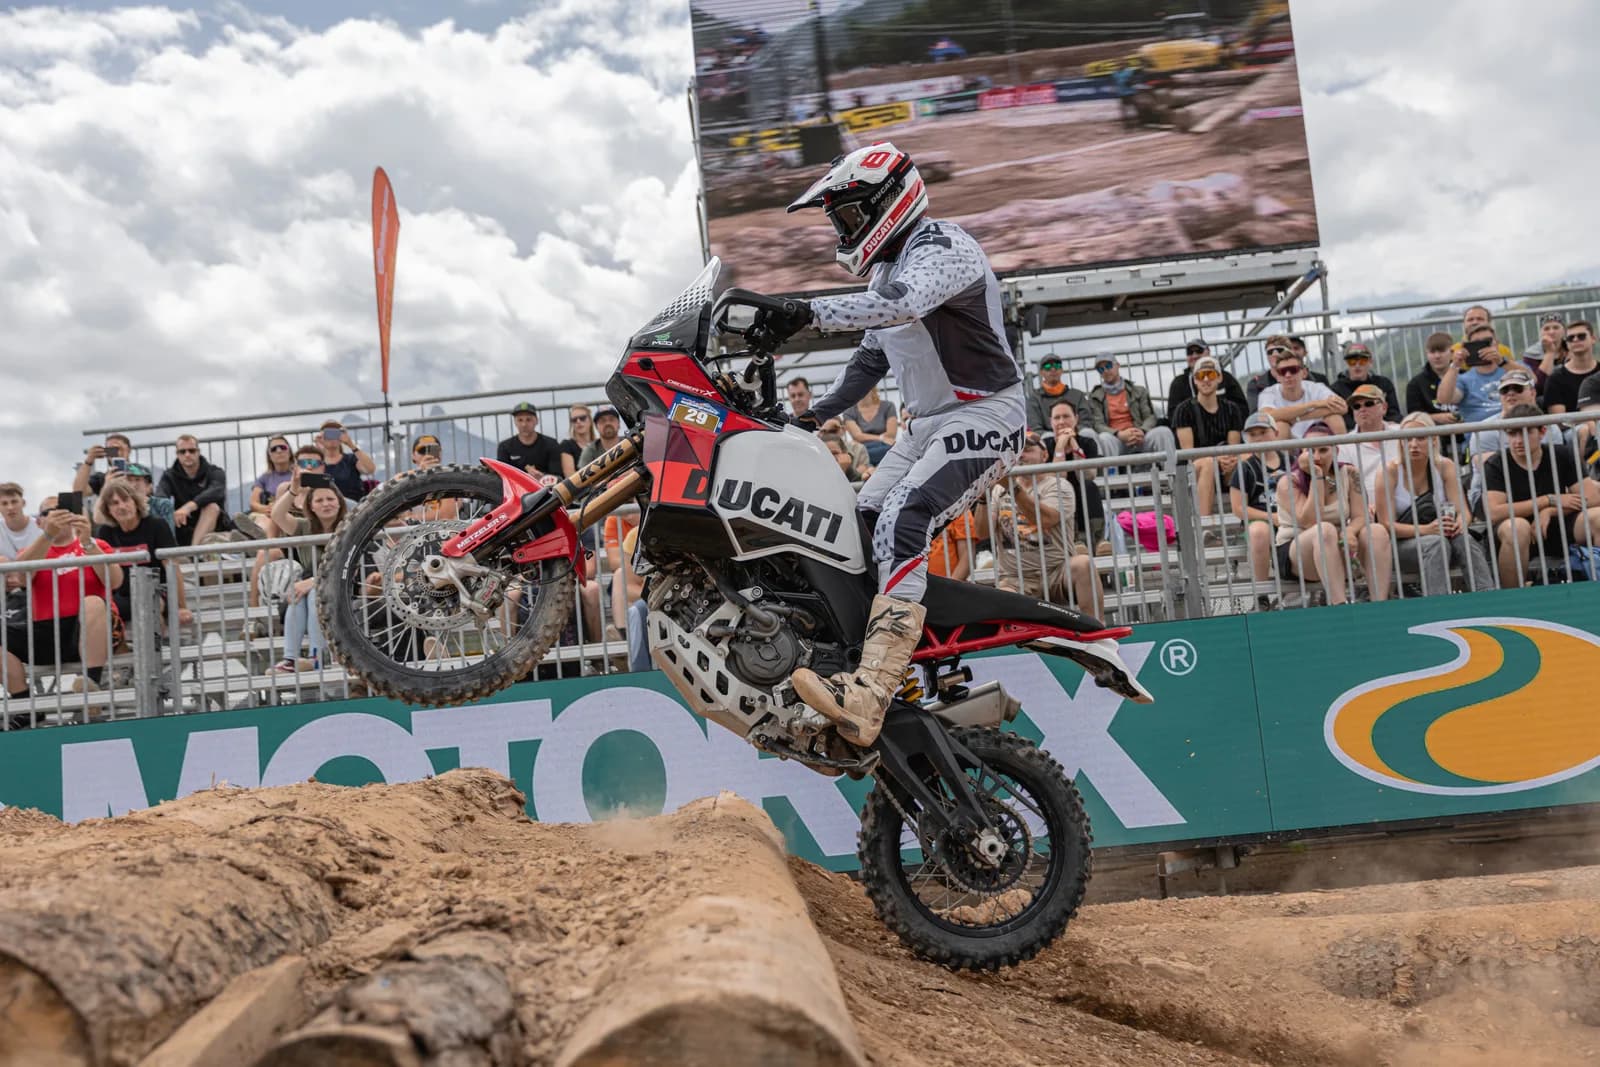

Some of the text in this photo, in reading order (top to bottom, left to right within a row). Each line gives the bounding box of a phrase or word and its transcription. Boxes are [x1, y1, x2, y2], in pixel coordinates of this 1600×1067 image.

[870, 176, 896, 205] DUCATI
[865, 218, 895, 253] DUCATI
[684, 408, 708, 425] 29
[943, 425, 1025, 455] DUCATI
[682, 468, 843, 545] DUCATI
[61, 640, 1188, 857] MOTORX
